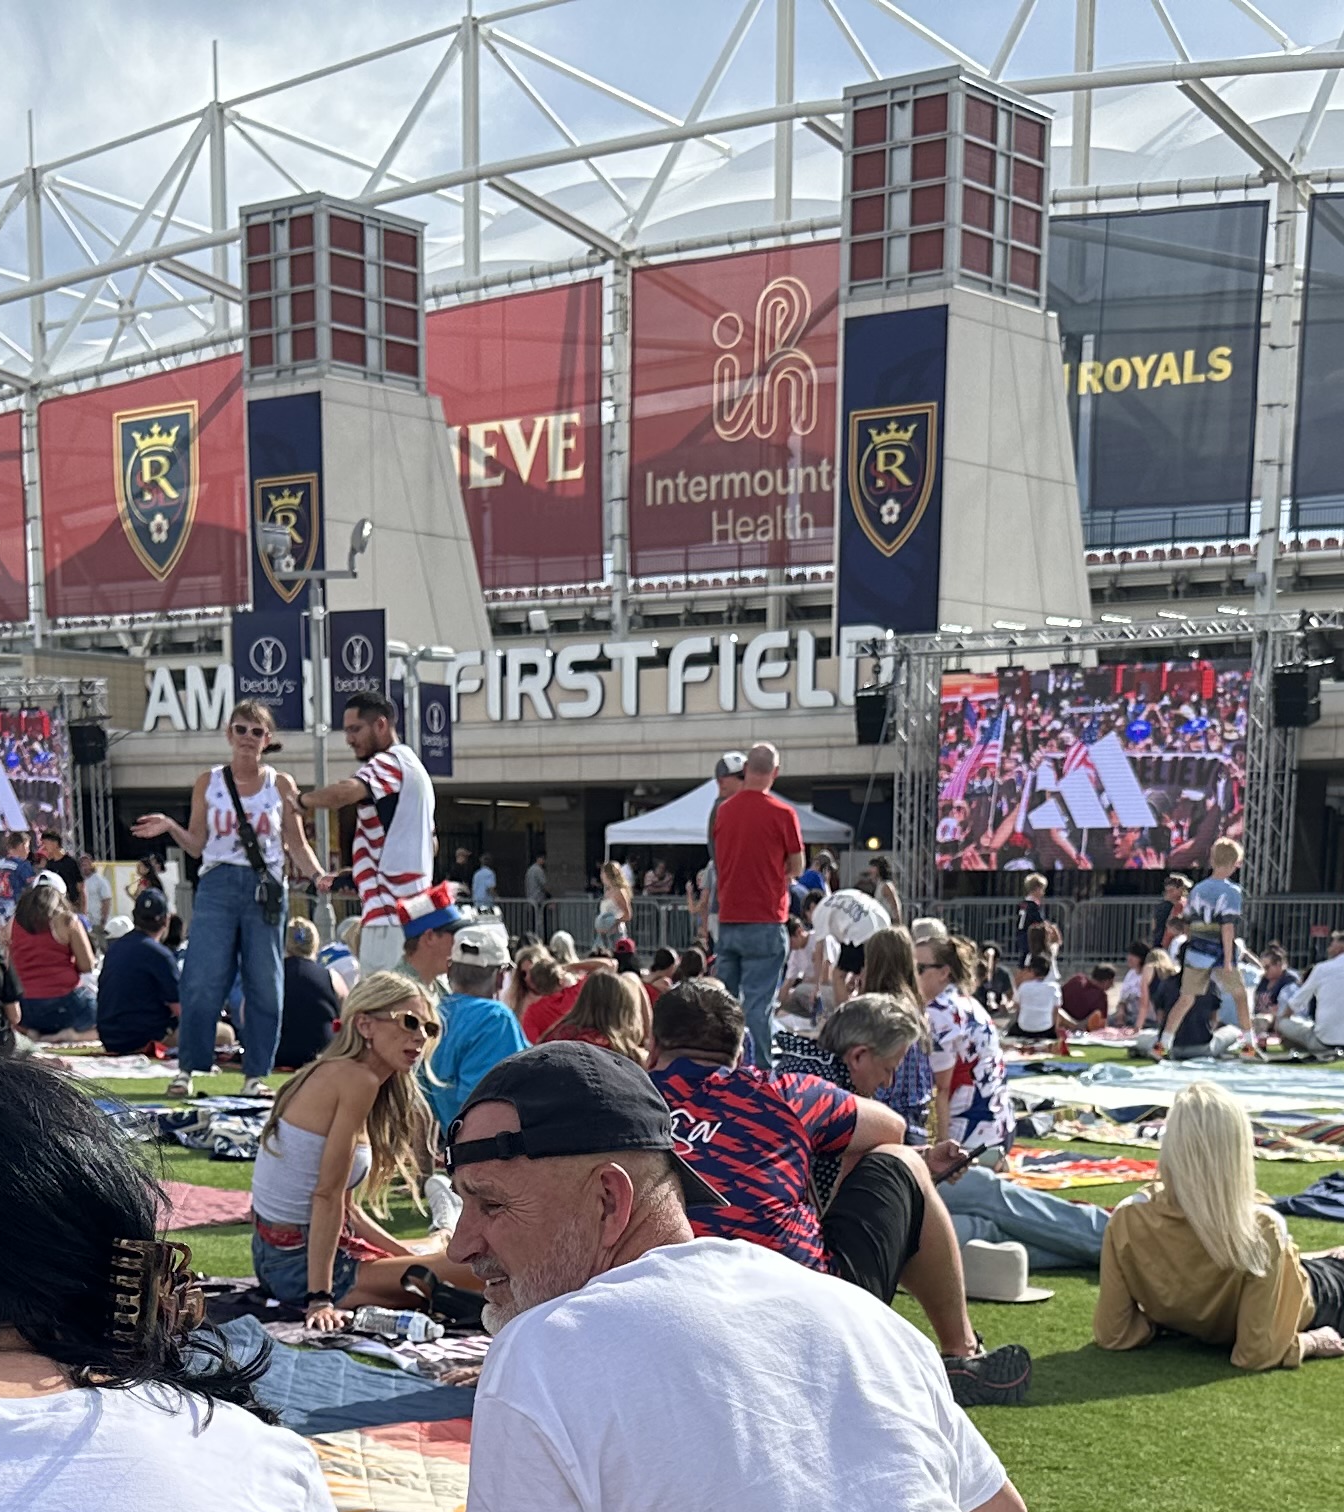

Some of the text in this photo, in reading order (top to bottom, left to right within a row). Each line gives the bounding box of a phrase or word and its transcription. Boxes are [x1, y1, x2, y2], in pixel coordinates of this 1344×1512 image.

[1077, 346, 1233, 396] ROYALS
[447, 412, 586, 490] IEVE
[645, 457, 838, 508] Intermount
[711, 504, 814, 546] Health
[239, 676, 298, 698] beddy's
[449, 640, 657, 722] FIRST
[214, 808, 271, 837] UA
